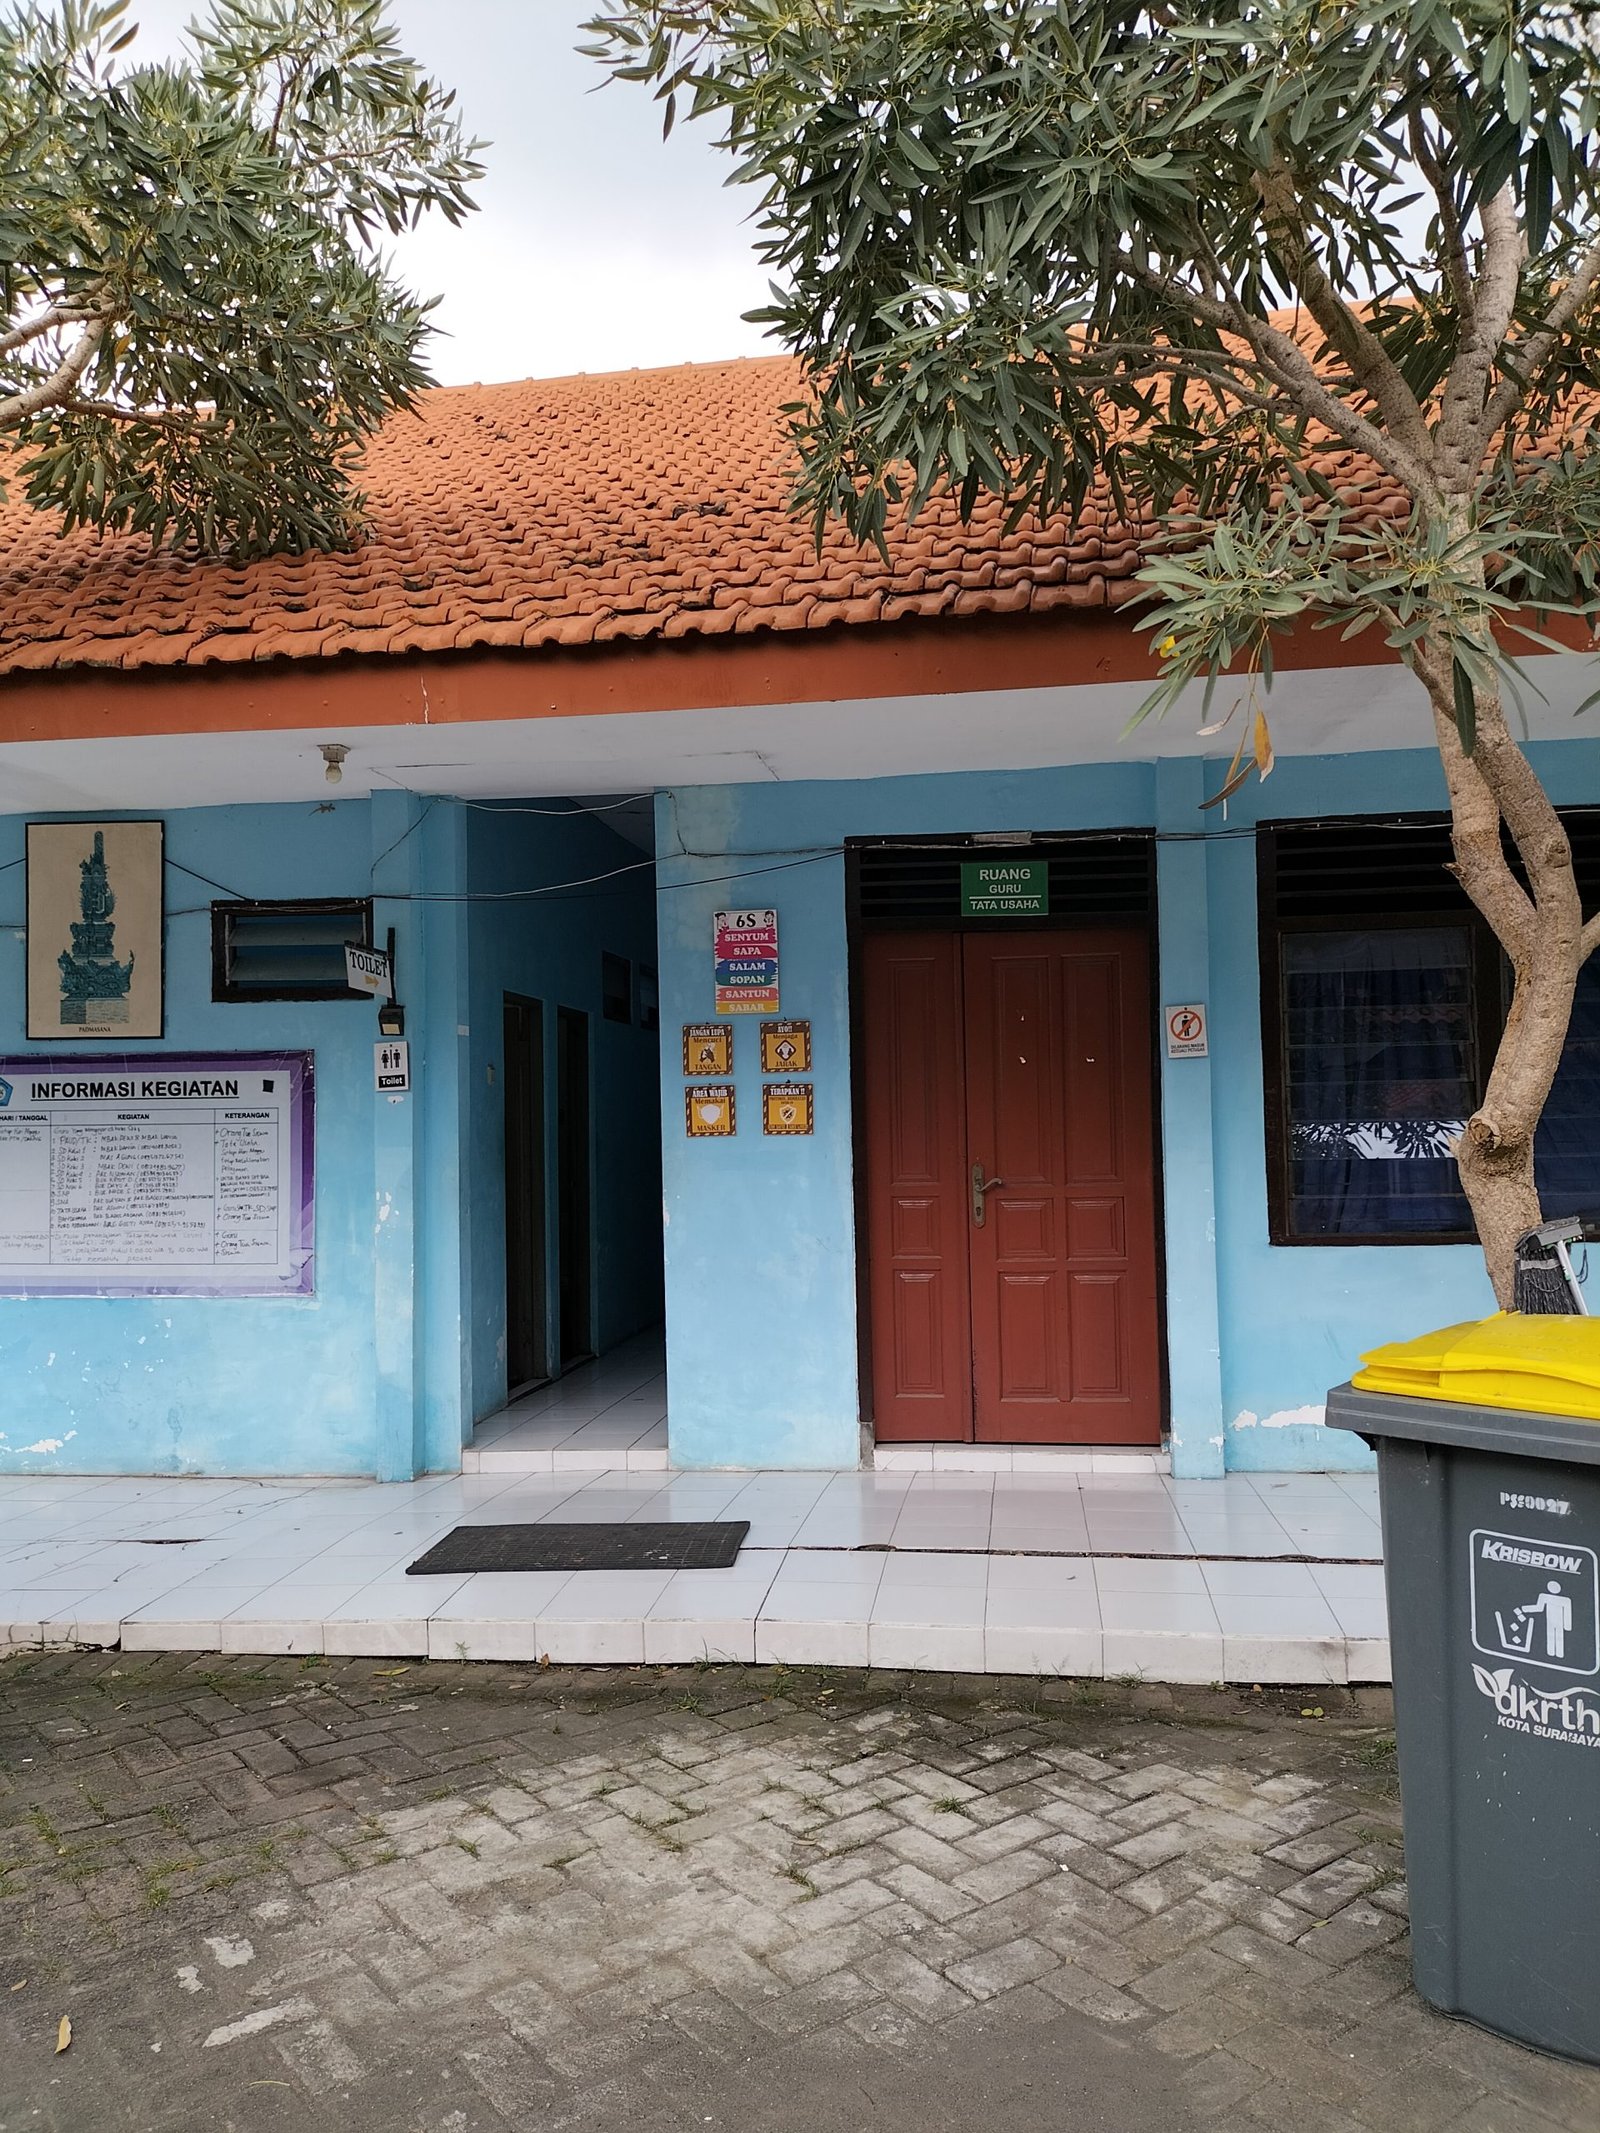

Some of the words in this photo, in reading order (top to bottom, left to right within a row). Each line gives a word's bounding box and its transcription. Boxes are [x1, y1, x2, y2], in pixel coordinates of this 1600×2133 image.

[979, 868, 1031, 880] RUANG
[989, 884, 1021, 893] GURU
[970, 900, 997, 910] TATA
[1000, 899, 1040, 909] USAHA
[736, 913, 756, 928] 6S
[724, 932, 769, 941] SENYUM
[733, 947, 761, 955] SAPA
[350, 951, 387, 977] TOILET
[729, 962, 766, 970] SALAM
[730, 975, 765, 984] SOPAN
[725, 989, 770, 998] SANTUN
[728, 1003, 765, 1011] SABAR
[690, 1028, 710, 1037] JANGAN
[711, 1028, 725, 1036] LUPA
[381, 1077, 403, 1085] Toilet
[31, 1081, 136, 1099] INFORMASI
[141, 1080, 239, 1098] KEGIATAN
[692, 1090, 708, 1098] AREA
[709, 1089, 728, 1097] WAJIB
[1495, 1684, 1600, 1735] dkrth
[1497, 1714, 1531, 1733] KOTA
[1533, 1724, 1600, 1748] SURABAYA
